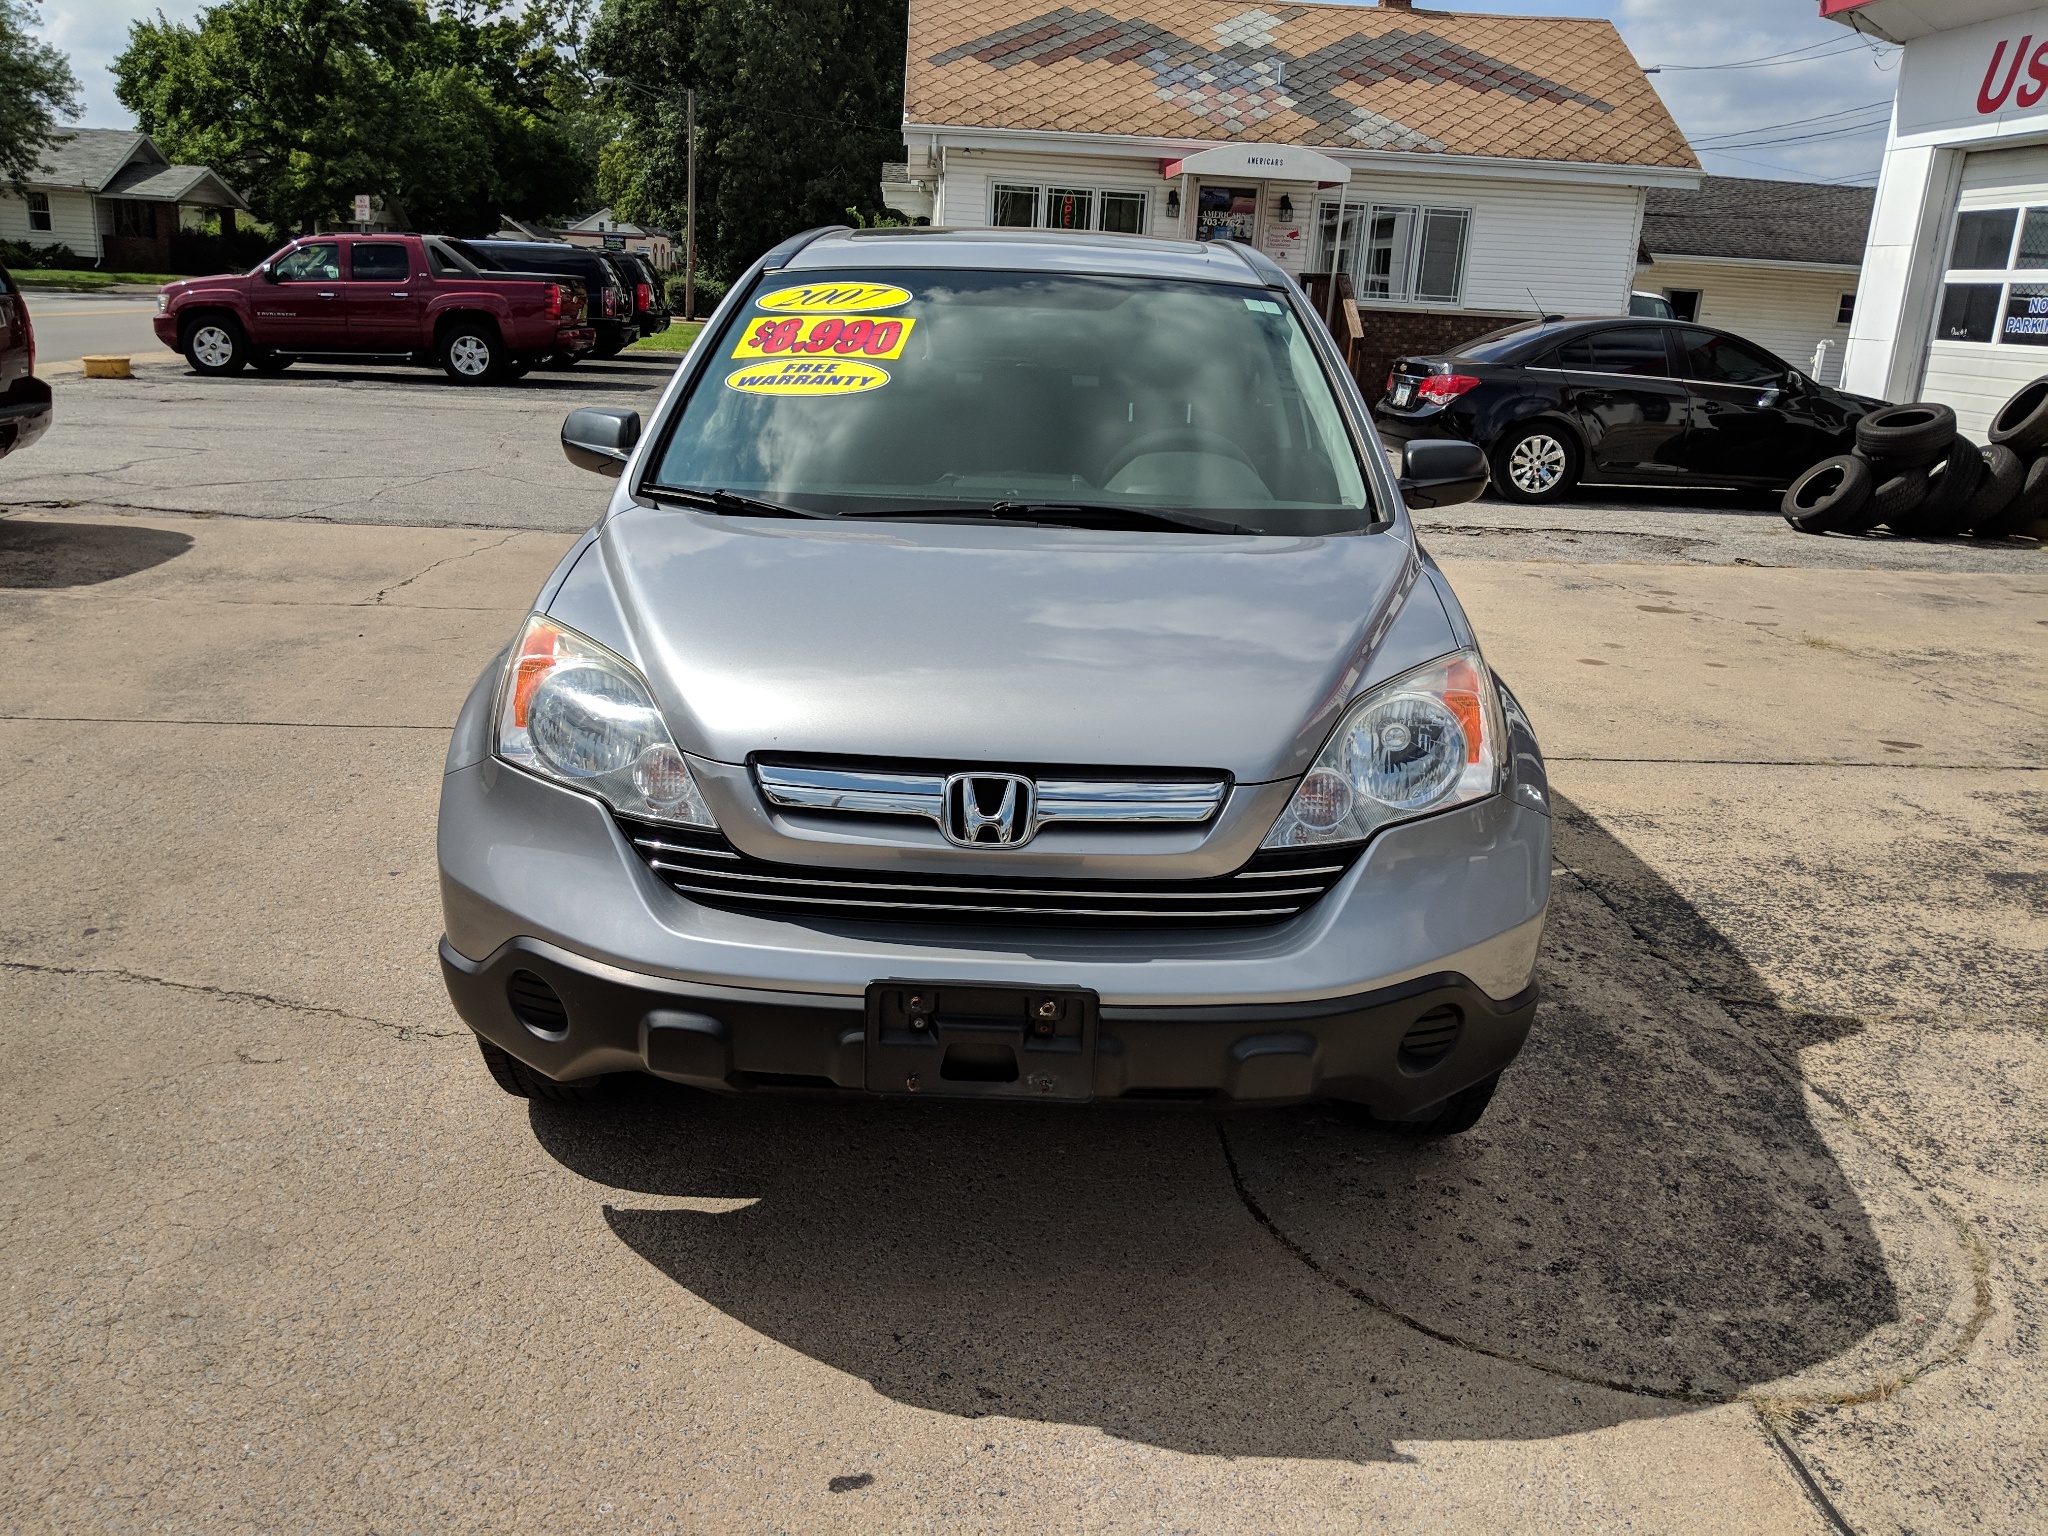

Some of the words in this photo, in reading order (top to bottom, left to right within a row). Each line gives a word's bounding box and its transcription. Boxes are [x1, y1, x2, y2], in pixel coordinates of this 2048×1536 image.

[1247, 156, 1284, 166] AMERICARS
[1064, 195, 1073, 227] OPE
[1202, 210, 1246, 219] AMERICARS
[1202, 217, 1240, 227] 703-7762
[770, 287, 894, 308] 2007
[2028, 297, 2048, 313] NO
[781, 363, 841, 374] FREE
[736, 374, 878, 387] WARRANTY
